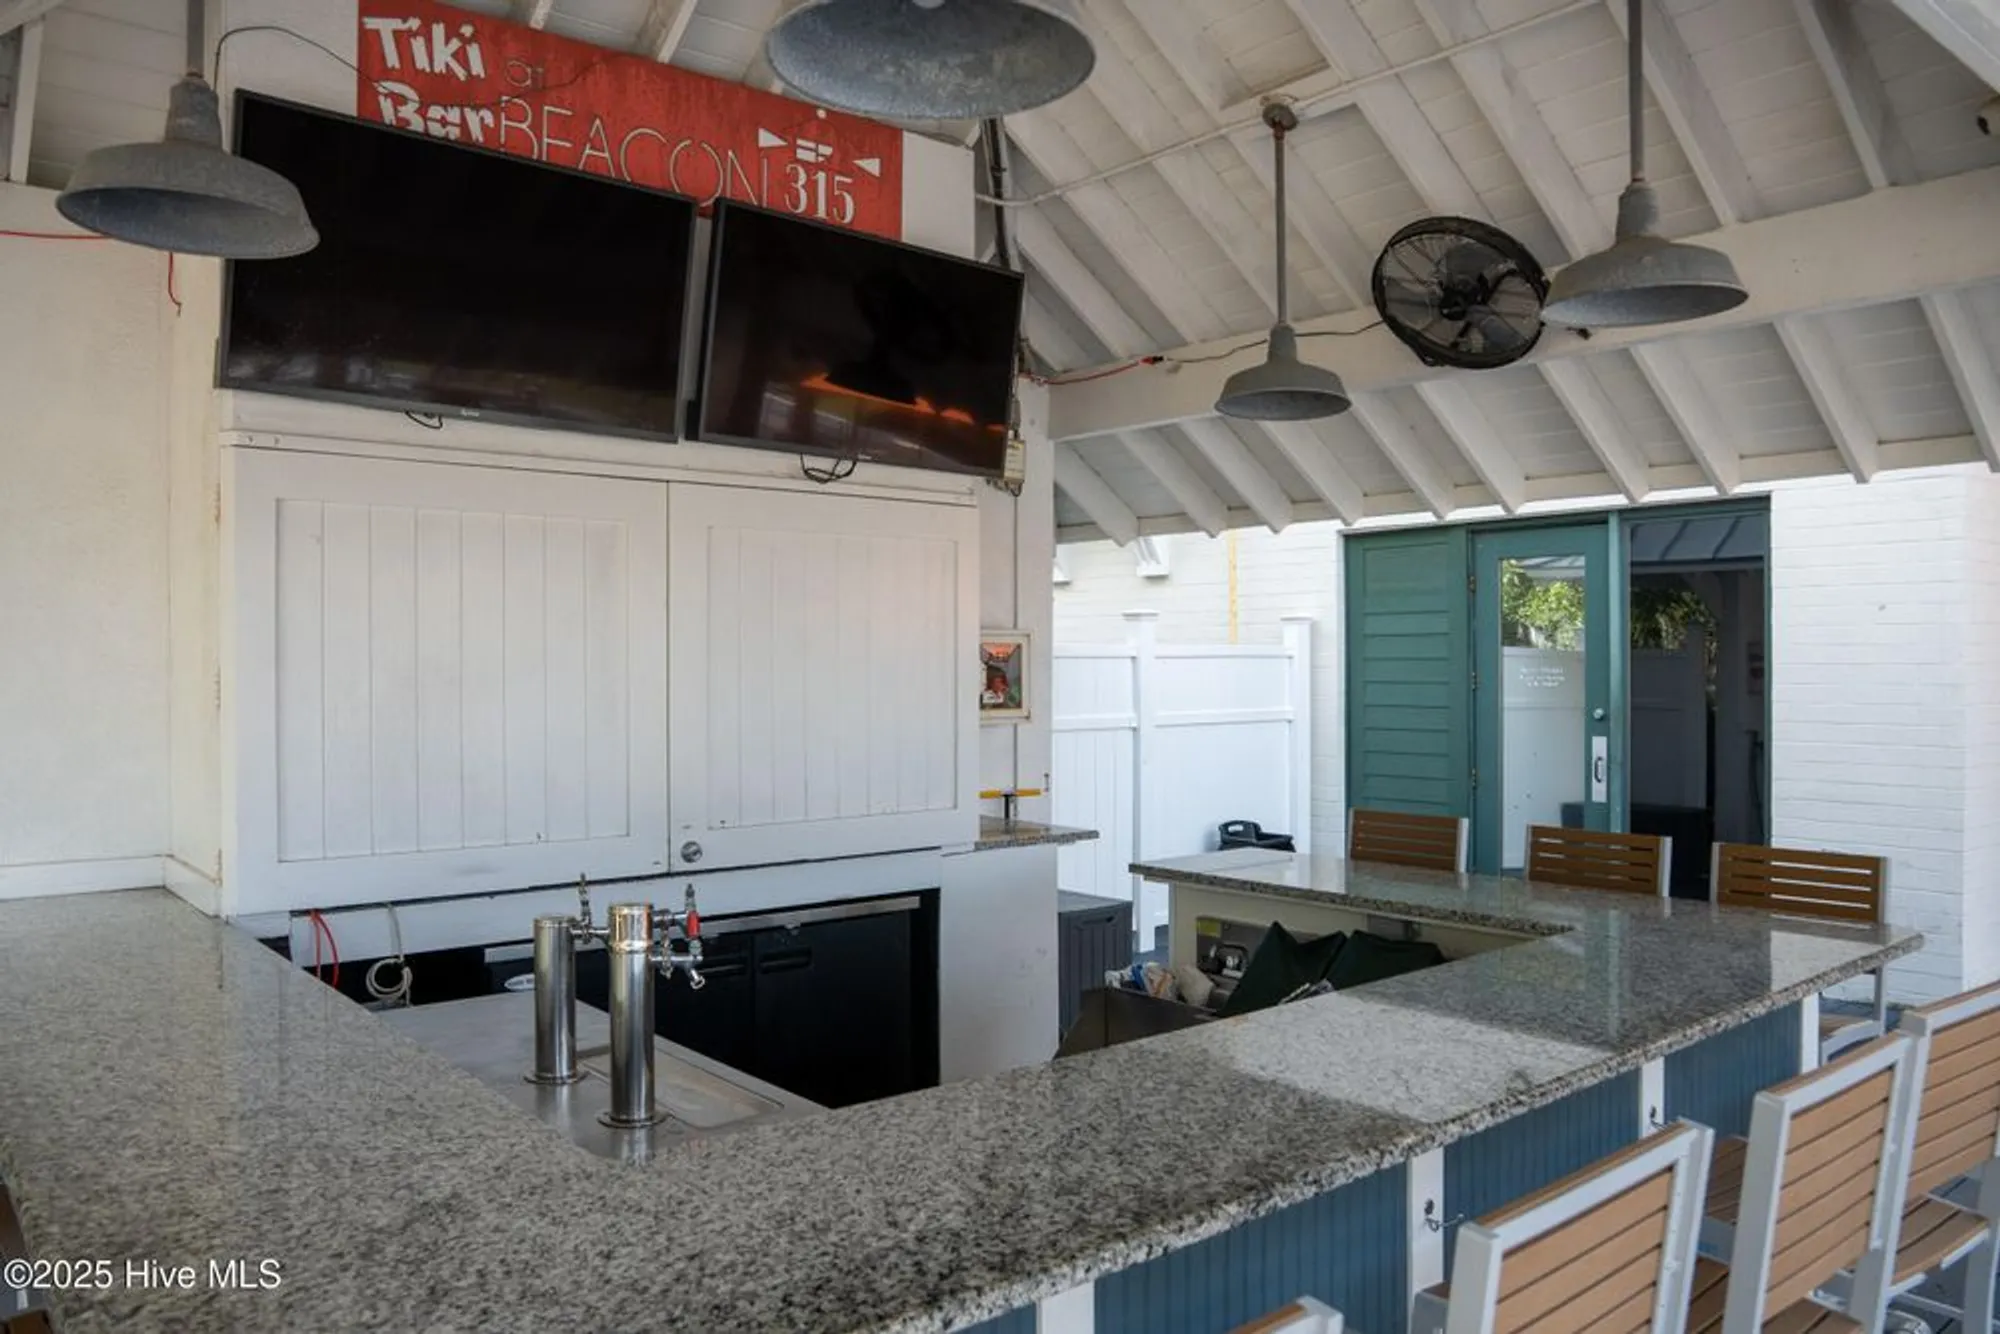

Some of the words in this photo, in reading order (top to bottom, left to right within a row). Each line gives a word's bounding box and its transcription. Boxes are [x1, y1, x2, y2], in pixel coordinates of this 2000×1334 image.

[362, 16, 486, 82] Tiki
[372, 80, 495, 143] Bar
[500, 95, 768, 208] BEACON
[784, 163, 854, 224] 315
